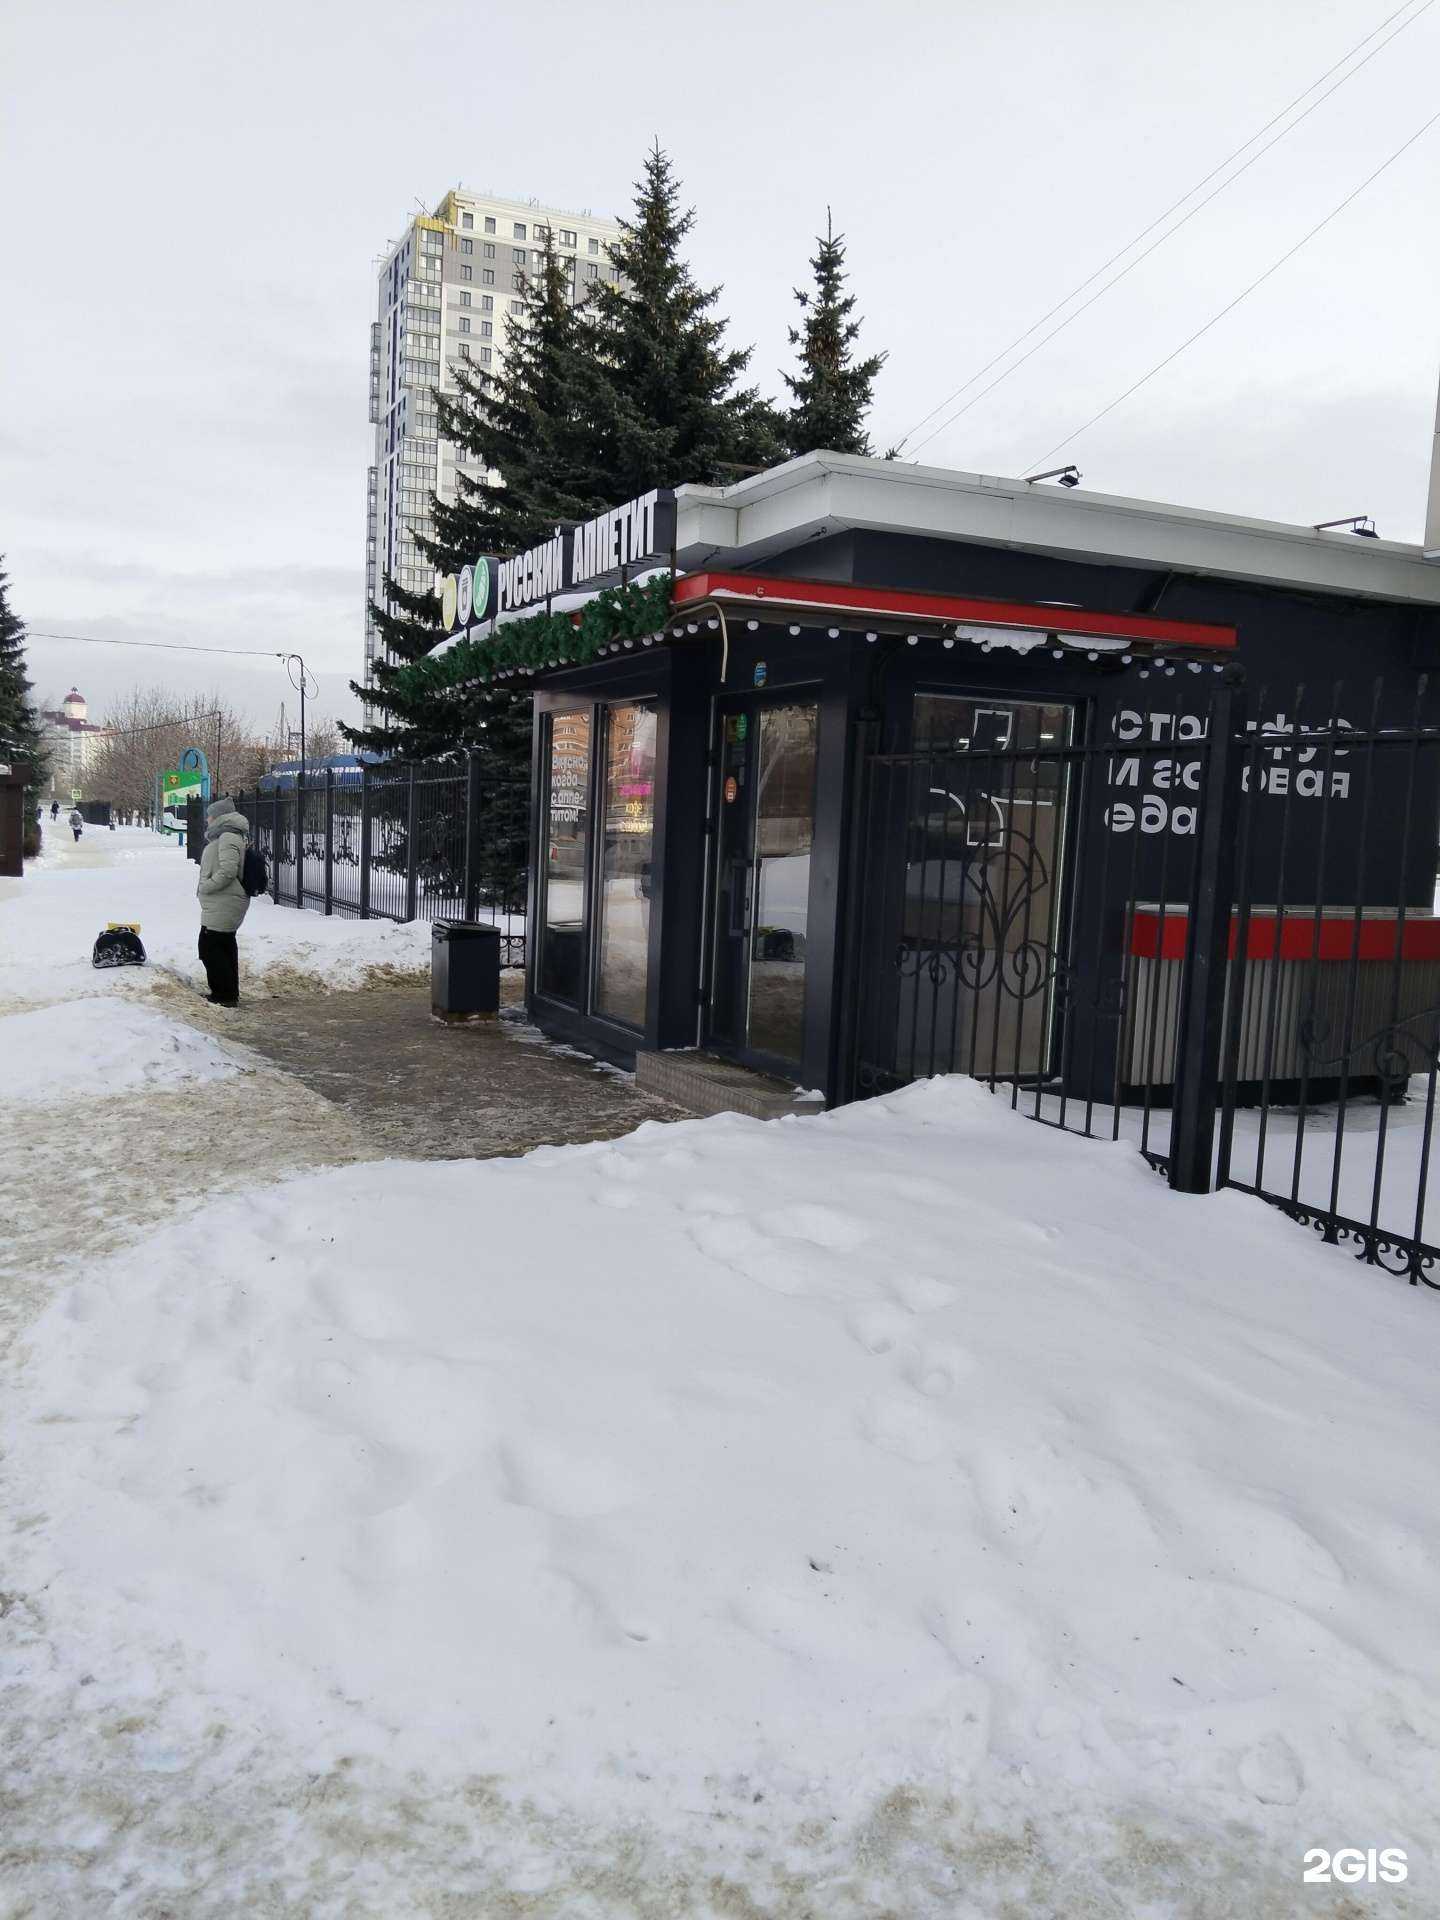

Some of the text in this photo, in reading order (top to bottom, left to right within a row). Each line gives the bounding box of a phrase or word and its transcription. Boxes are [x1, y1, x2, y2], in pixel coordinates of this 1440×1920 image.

[498, 488, 658, 612] РУССКИЙ АППЕТИТ
[1152, 759, 1350, 799] гоовая
[1104, 794, 1198, 834] еда
